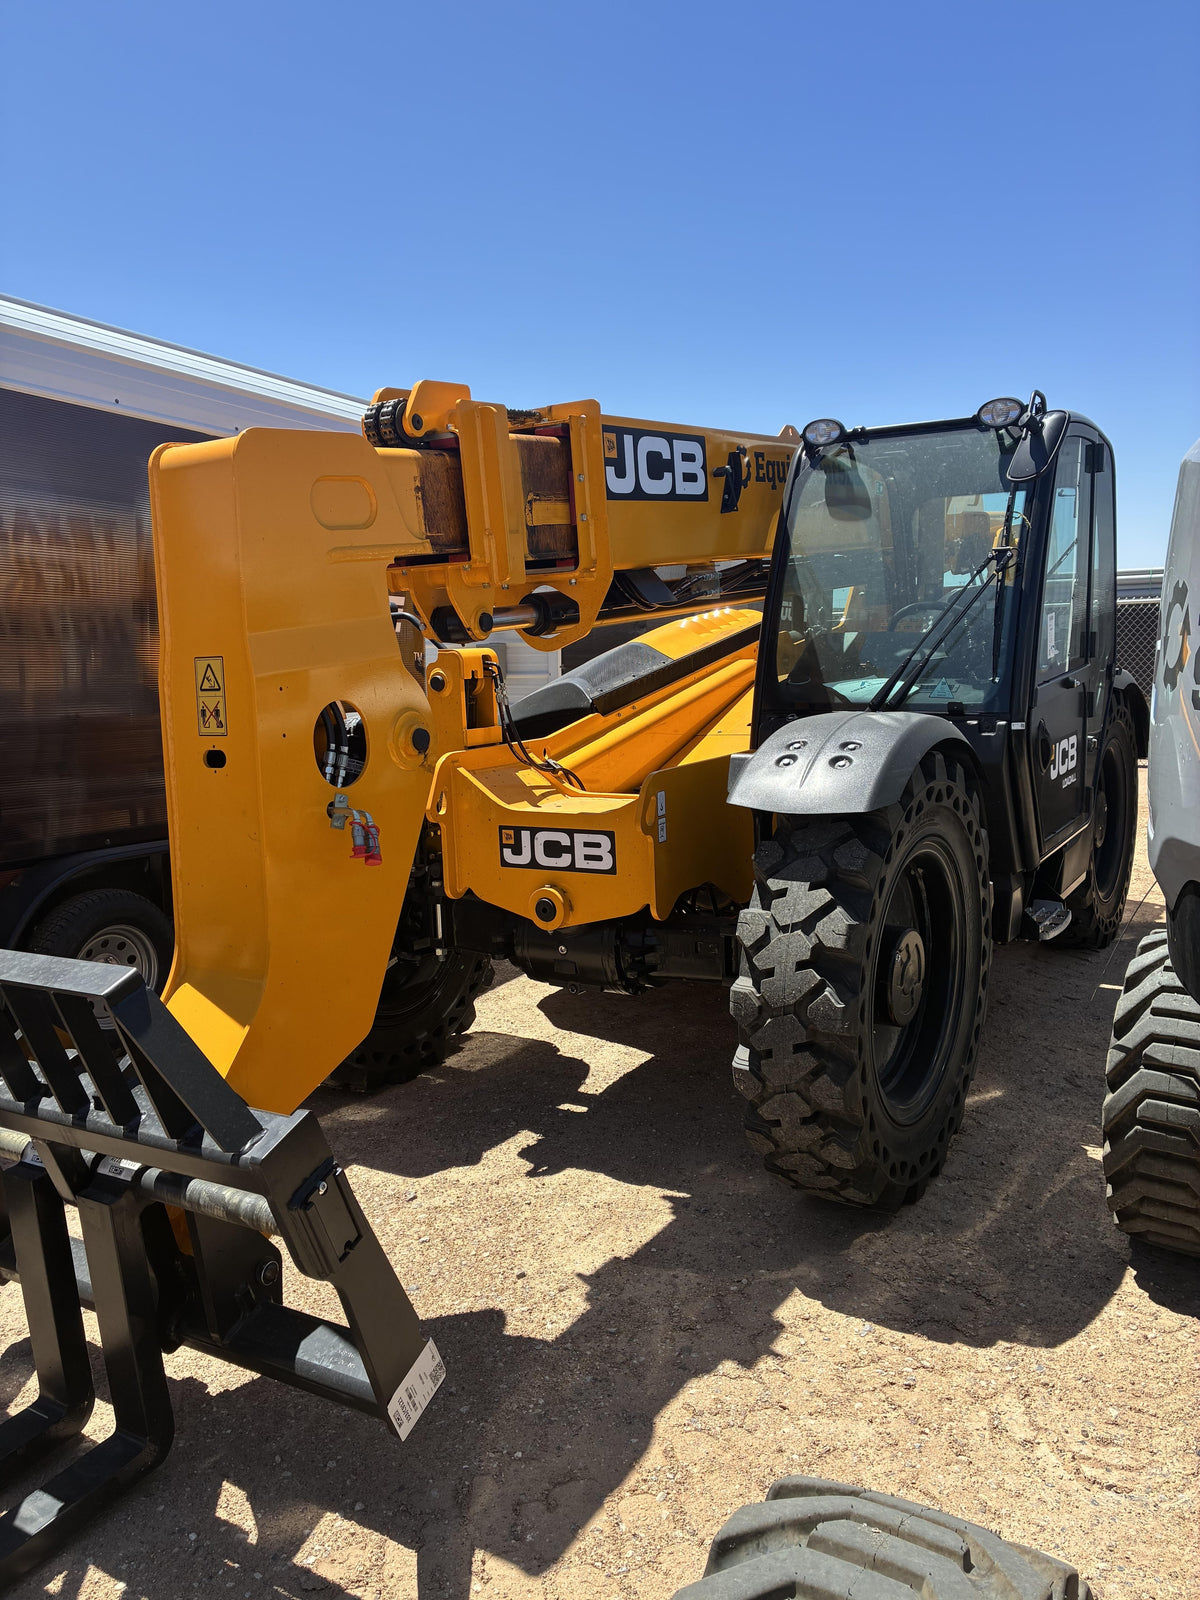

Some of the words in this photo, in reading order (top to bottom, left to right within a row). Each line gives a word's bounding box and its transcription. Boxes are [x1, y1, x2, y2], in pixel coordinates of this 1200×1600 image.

[605, 434, 706, 495] JCB
[1050, 734, 1077, 780] JCB
[502, 830, 614, 871] JCB
